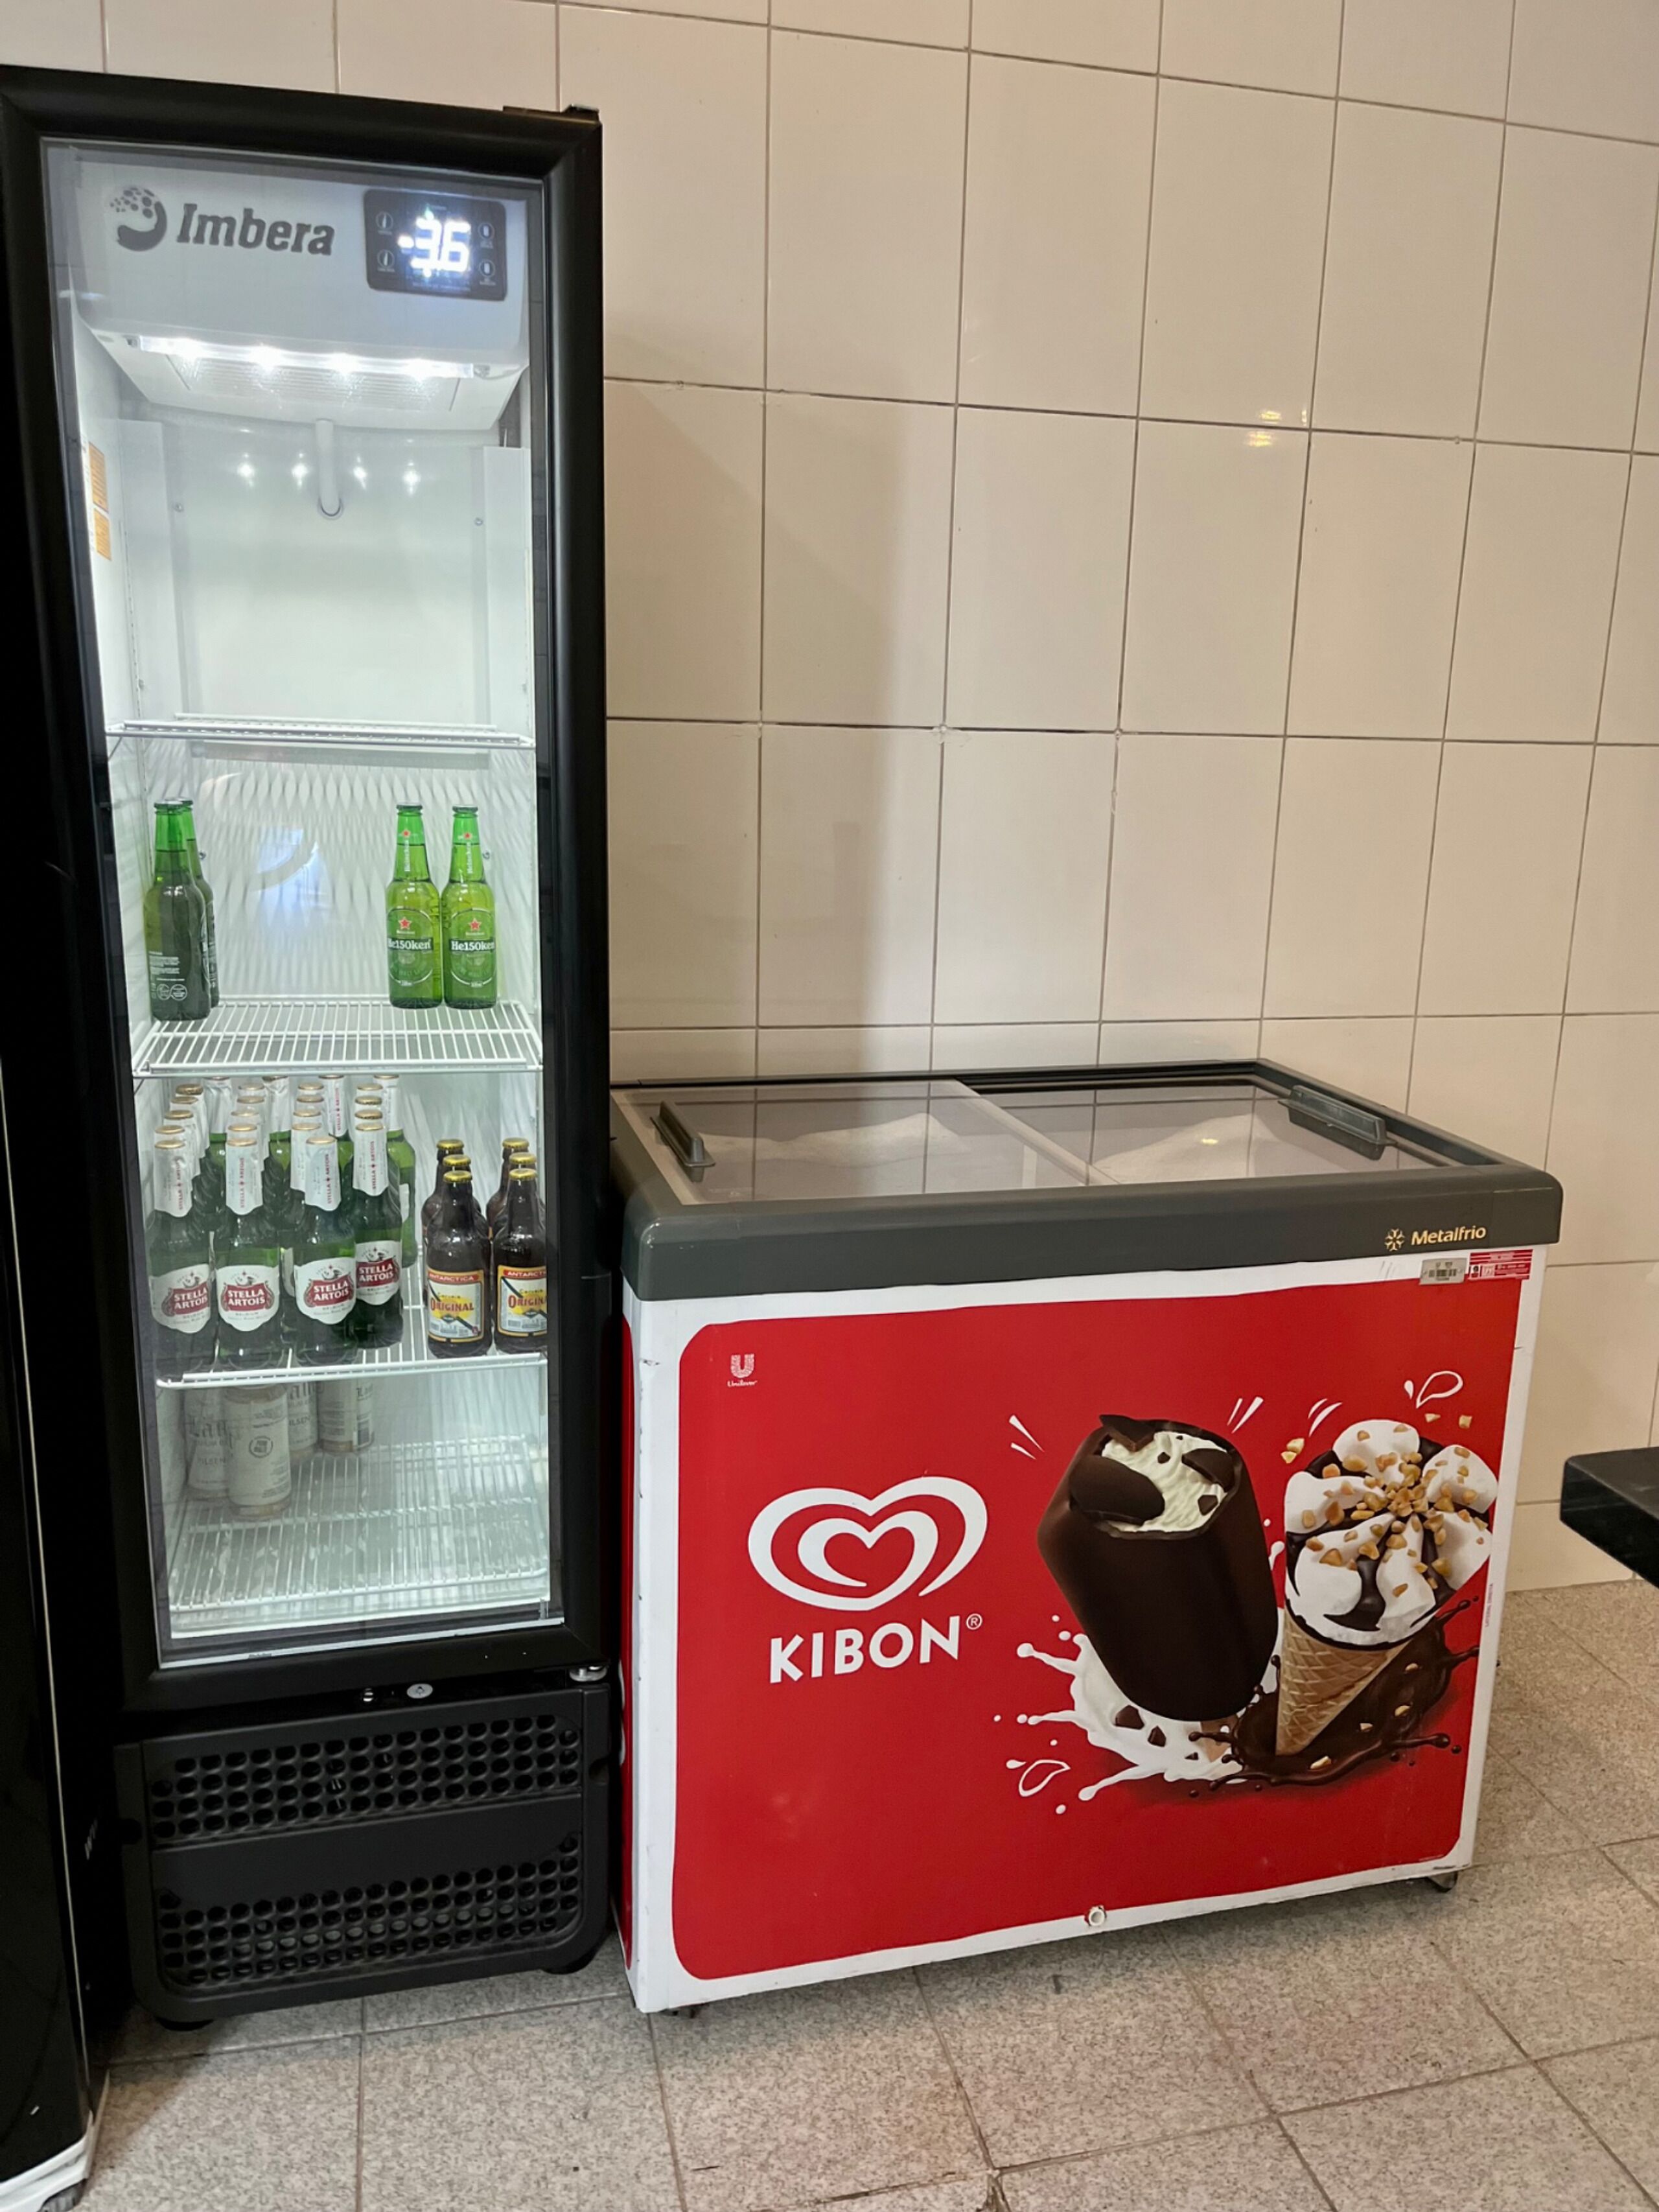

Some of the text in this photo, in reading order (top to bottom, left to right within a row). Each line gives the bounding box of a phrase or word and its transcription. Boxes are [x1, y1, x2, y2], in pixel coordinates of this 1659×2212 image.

[177, 203, 335, 256] Imbera
[1411, 1225, 1487, 1246] Metalfrio
[358, 1263, 393, 1275] STELLA
[358, 1270, 394, 1282] ARTOIS
[227, 1288, 265, 1298] STELLA
[313, 1280, 349, 1294] STELLA
[174, 1287, 208, 1302] STELLA
[227, 1296, 266, 1307] ARTOIS
[314, 1288, 350, 1301] ARTOIS
[174, 1295, 208, 1310] ARTOIS
[430, 1298, 474, 1312] ORIGINAL
